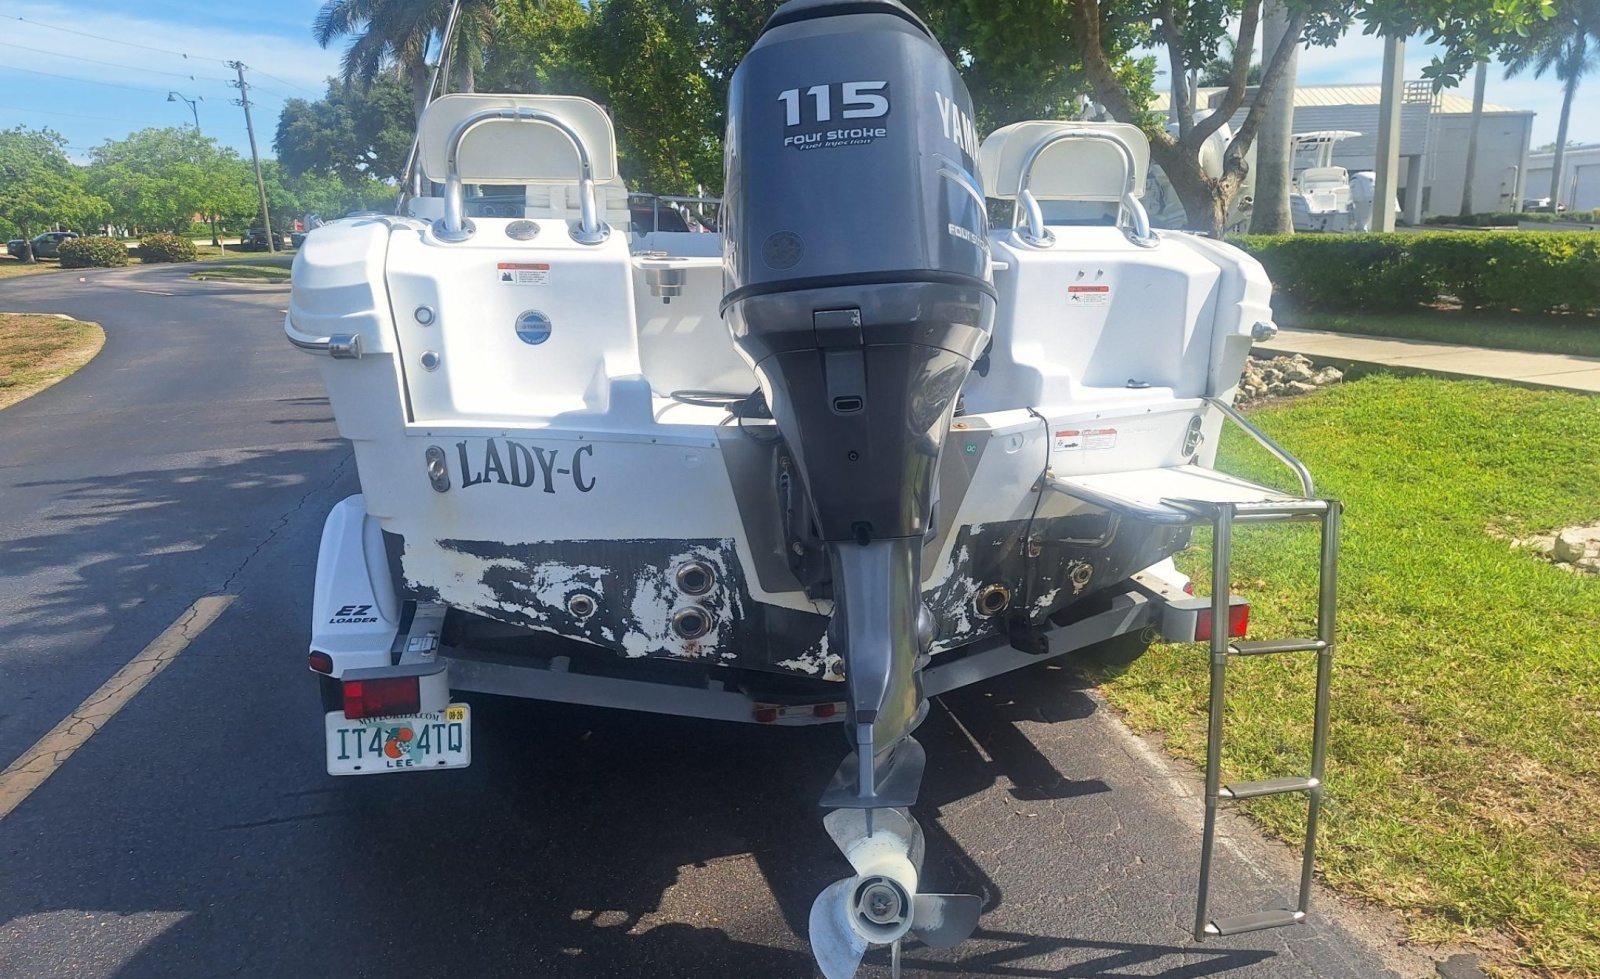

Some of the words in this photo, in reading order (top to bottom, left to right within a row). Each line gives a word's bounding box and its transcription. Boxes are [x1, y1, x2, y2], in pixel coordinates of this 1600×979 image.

[777, 81, 889, 126] 115
[799, 142, 822, 151] Fuel
[825, 139, 871, 148] Injection
[455, 437, 596, 494] LADY-C
[335, 605, 373, 616] EZ
[386, 759, 414, 768] LEE
